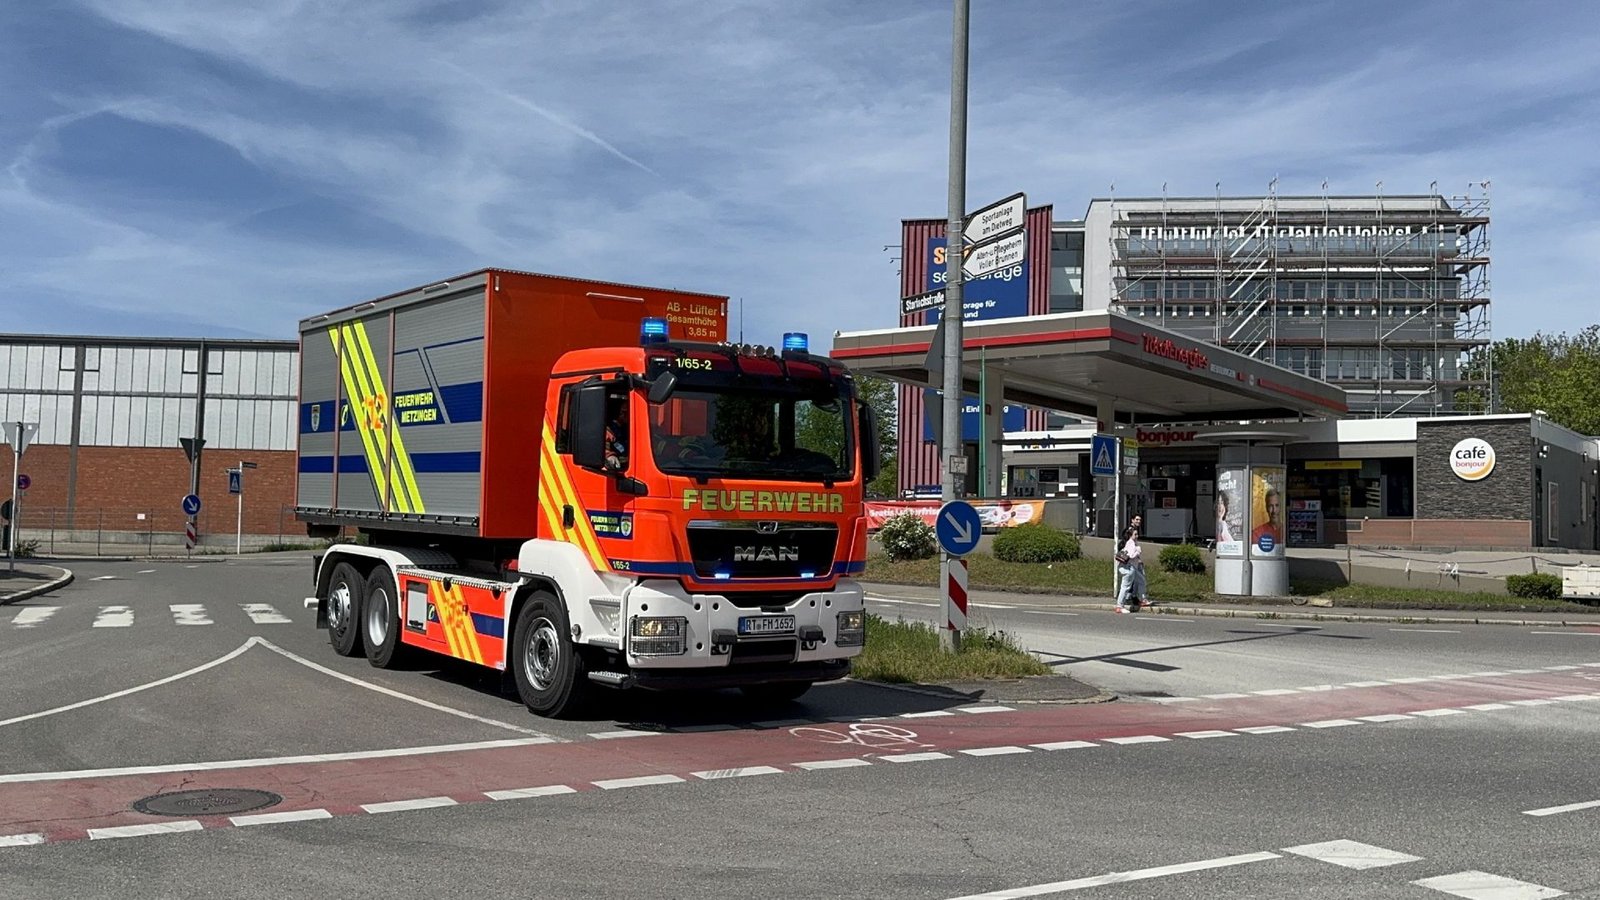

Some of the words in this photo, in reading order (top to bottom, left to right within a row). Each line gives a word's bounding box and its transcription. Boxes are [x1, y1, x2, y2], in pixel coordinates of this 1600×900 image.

[982, 206, 1013, 224] Sportanlage
[667, 302, 680, 312] AB
[689, 304, 718, 316] Lüfter
[985, 299, 997, 308] für
[665, 313, 718, 327] Gesamthöhe
[688, 327, 708, 337] 3,85
[709, 330, 717, 338] m
[675, 358, 713, 371] 1/65-2
[394, 392, 434, 408] FEUERWEHR
[401, 408, 438, 424] METZINGEN
[1136, 428, 1198, 446] bonjour
[1455, 445, 1486, 459] café
[1455, 460, 1486, 468] bonjour
[682, 489, 844, 513] FEUERWEHR
[733, 546, 799, 562] MAN
[746, 619, 757, 631] RT
[762, 619, 774, 630] FM
[774, 618, 794, 629] 1652
